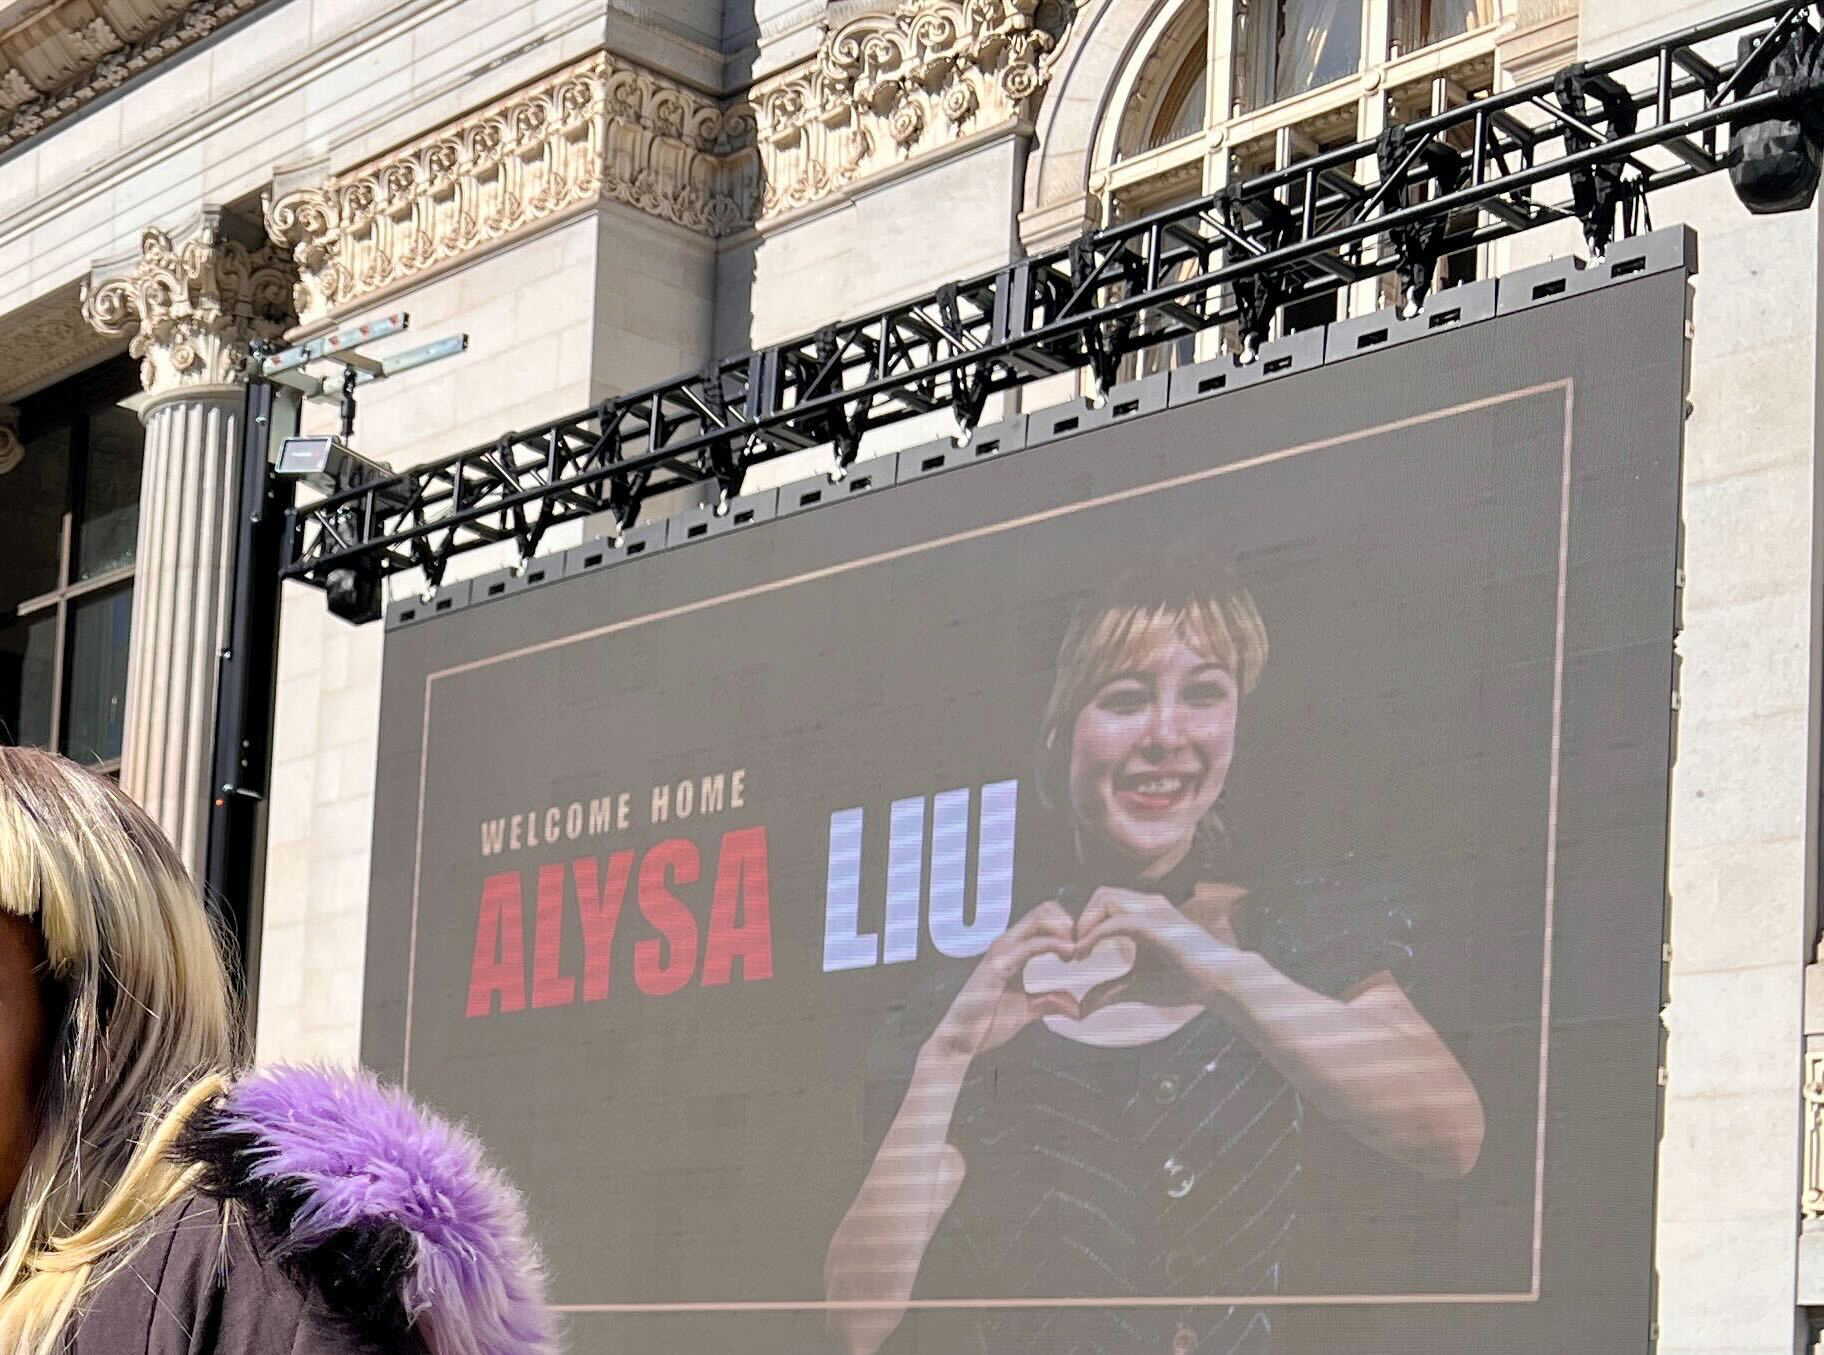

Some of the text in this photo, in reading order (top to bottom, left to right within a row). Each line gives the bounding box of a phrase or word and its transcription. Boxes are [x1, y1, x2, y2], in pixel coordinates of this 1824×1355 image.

[481, 768, 747, 857] WELCOME HOME
[465, 779, 1019, 1019] ALYSA LIU
